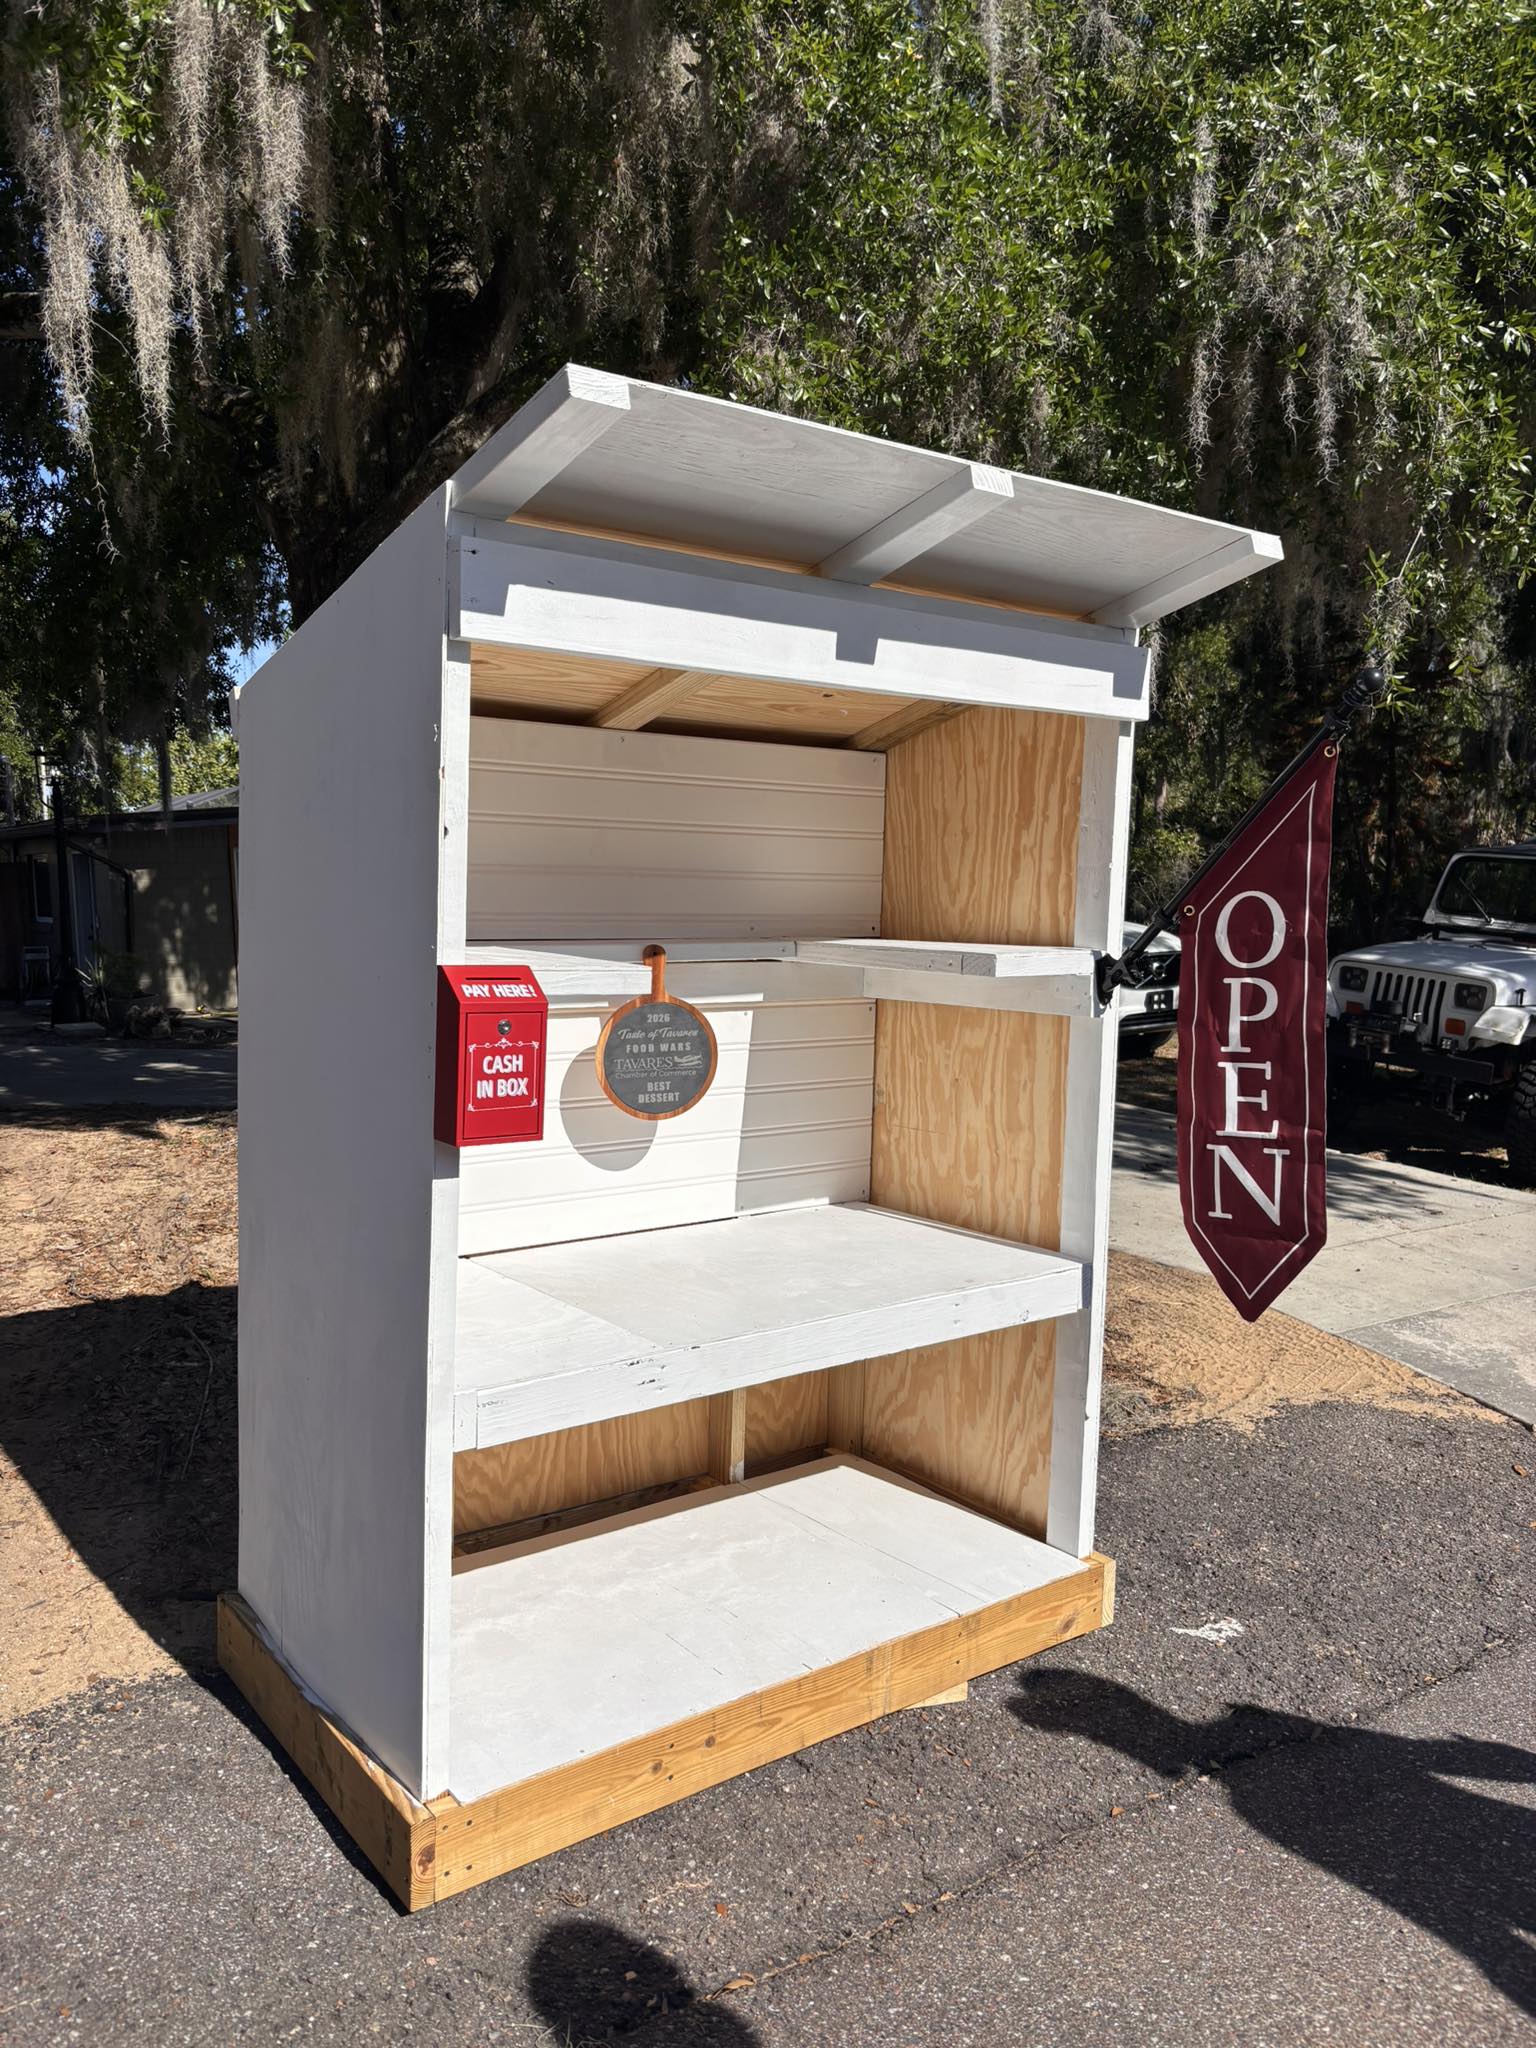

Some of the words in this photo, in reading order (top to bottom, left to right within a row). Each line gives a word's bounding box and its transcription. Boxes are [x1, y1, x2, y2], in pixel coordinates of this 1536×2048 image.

[461, 984, 490, 997] PAY
[492, 984, 537, 997] HERE!
[647, 1013, 670, 1023] 2026
[618, 1029, 645, 1040] Taste
[647, 1029, 658, 1040] of
[657, 1027, 698, 1039] Tavares
[626, 1044, 654, 1053] FOOD
[660, 1042, 691, 1052] WARS
[482, 1055, 523, 1074] CASH
[614, 1056, 673, 1071] TAVARES
[1206, 890, 1290, 1227] OPEN
[615, 1070, 647, 1079] Chamber
[649, 1069, 657, 1078] of
[659, 1069, 696, 1078] Commerce
[476, 1080, 493, 1099] IN
[496, 1077, 528, 1097] BOX
[647, 1081, 671, 1091] BEST
[638, 1092, 680, 1104] DESSERT
